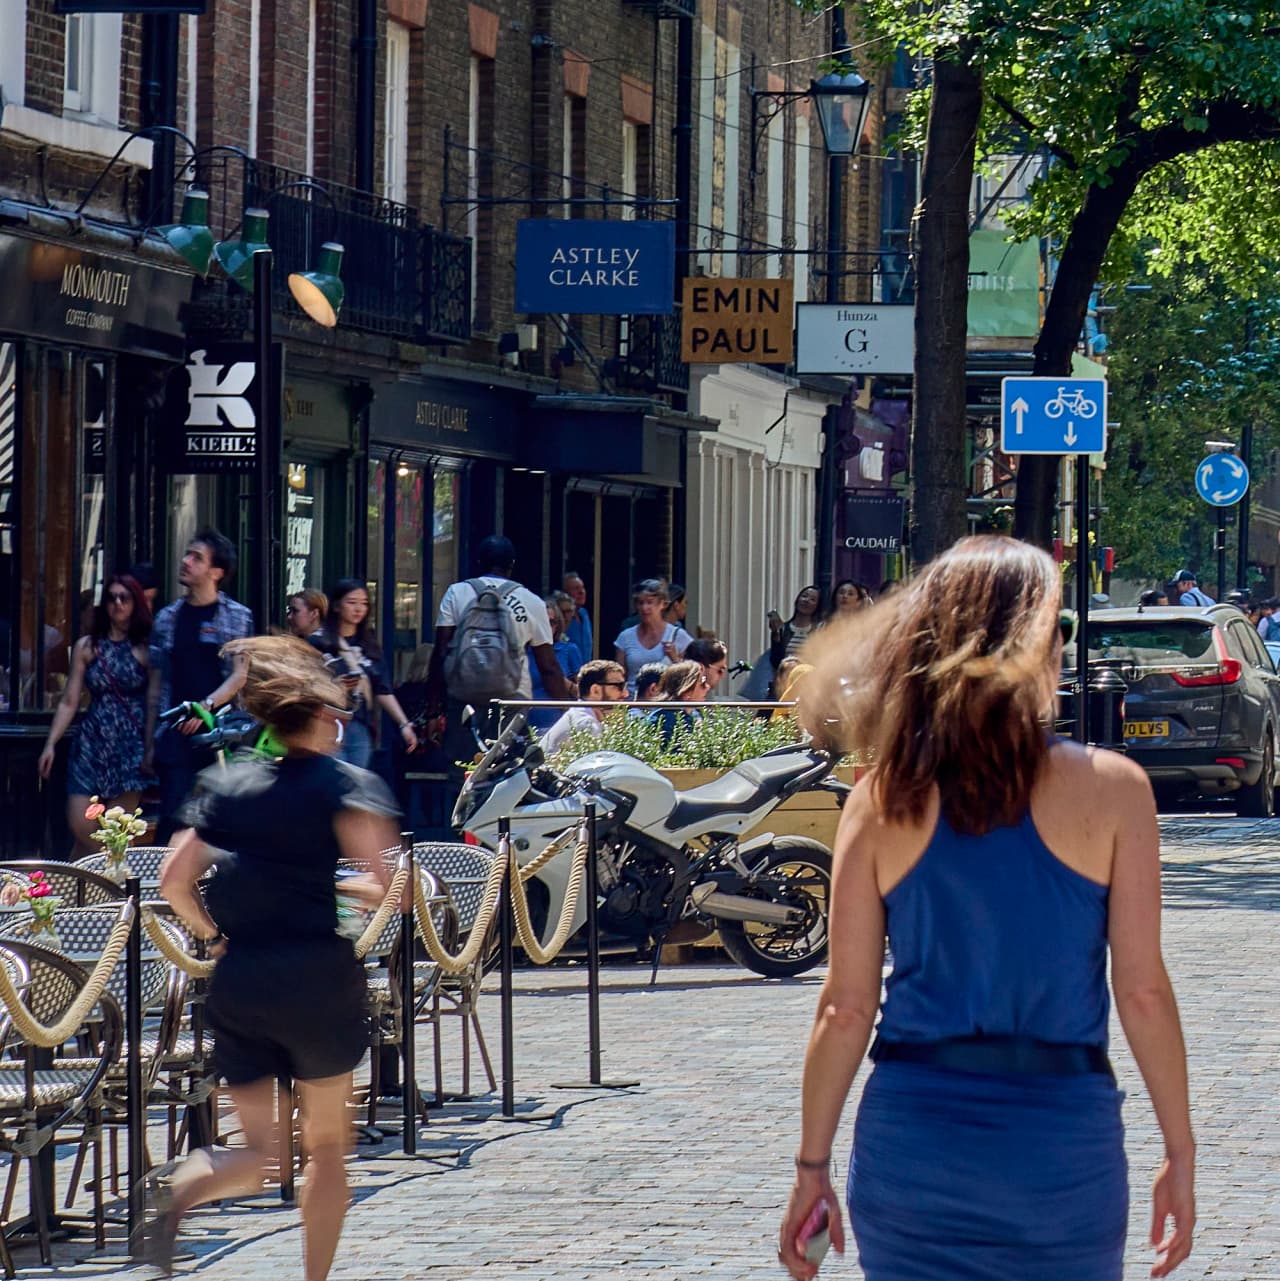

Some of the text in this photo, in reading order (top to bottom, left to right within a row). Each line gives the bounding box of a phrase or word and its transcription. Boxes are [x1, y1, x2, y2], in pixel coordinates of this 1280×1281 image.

[60, 264, 130, 306] MONMOUTH
[549, 270, 639, 286] CLARKE
[692, 288, 780, 313] EMIN
[836, 310, 878, 322] Hunza
[692, 328, 778, 354] PAUL
[844, 328, 869, 353] G
